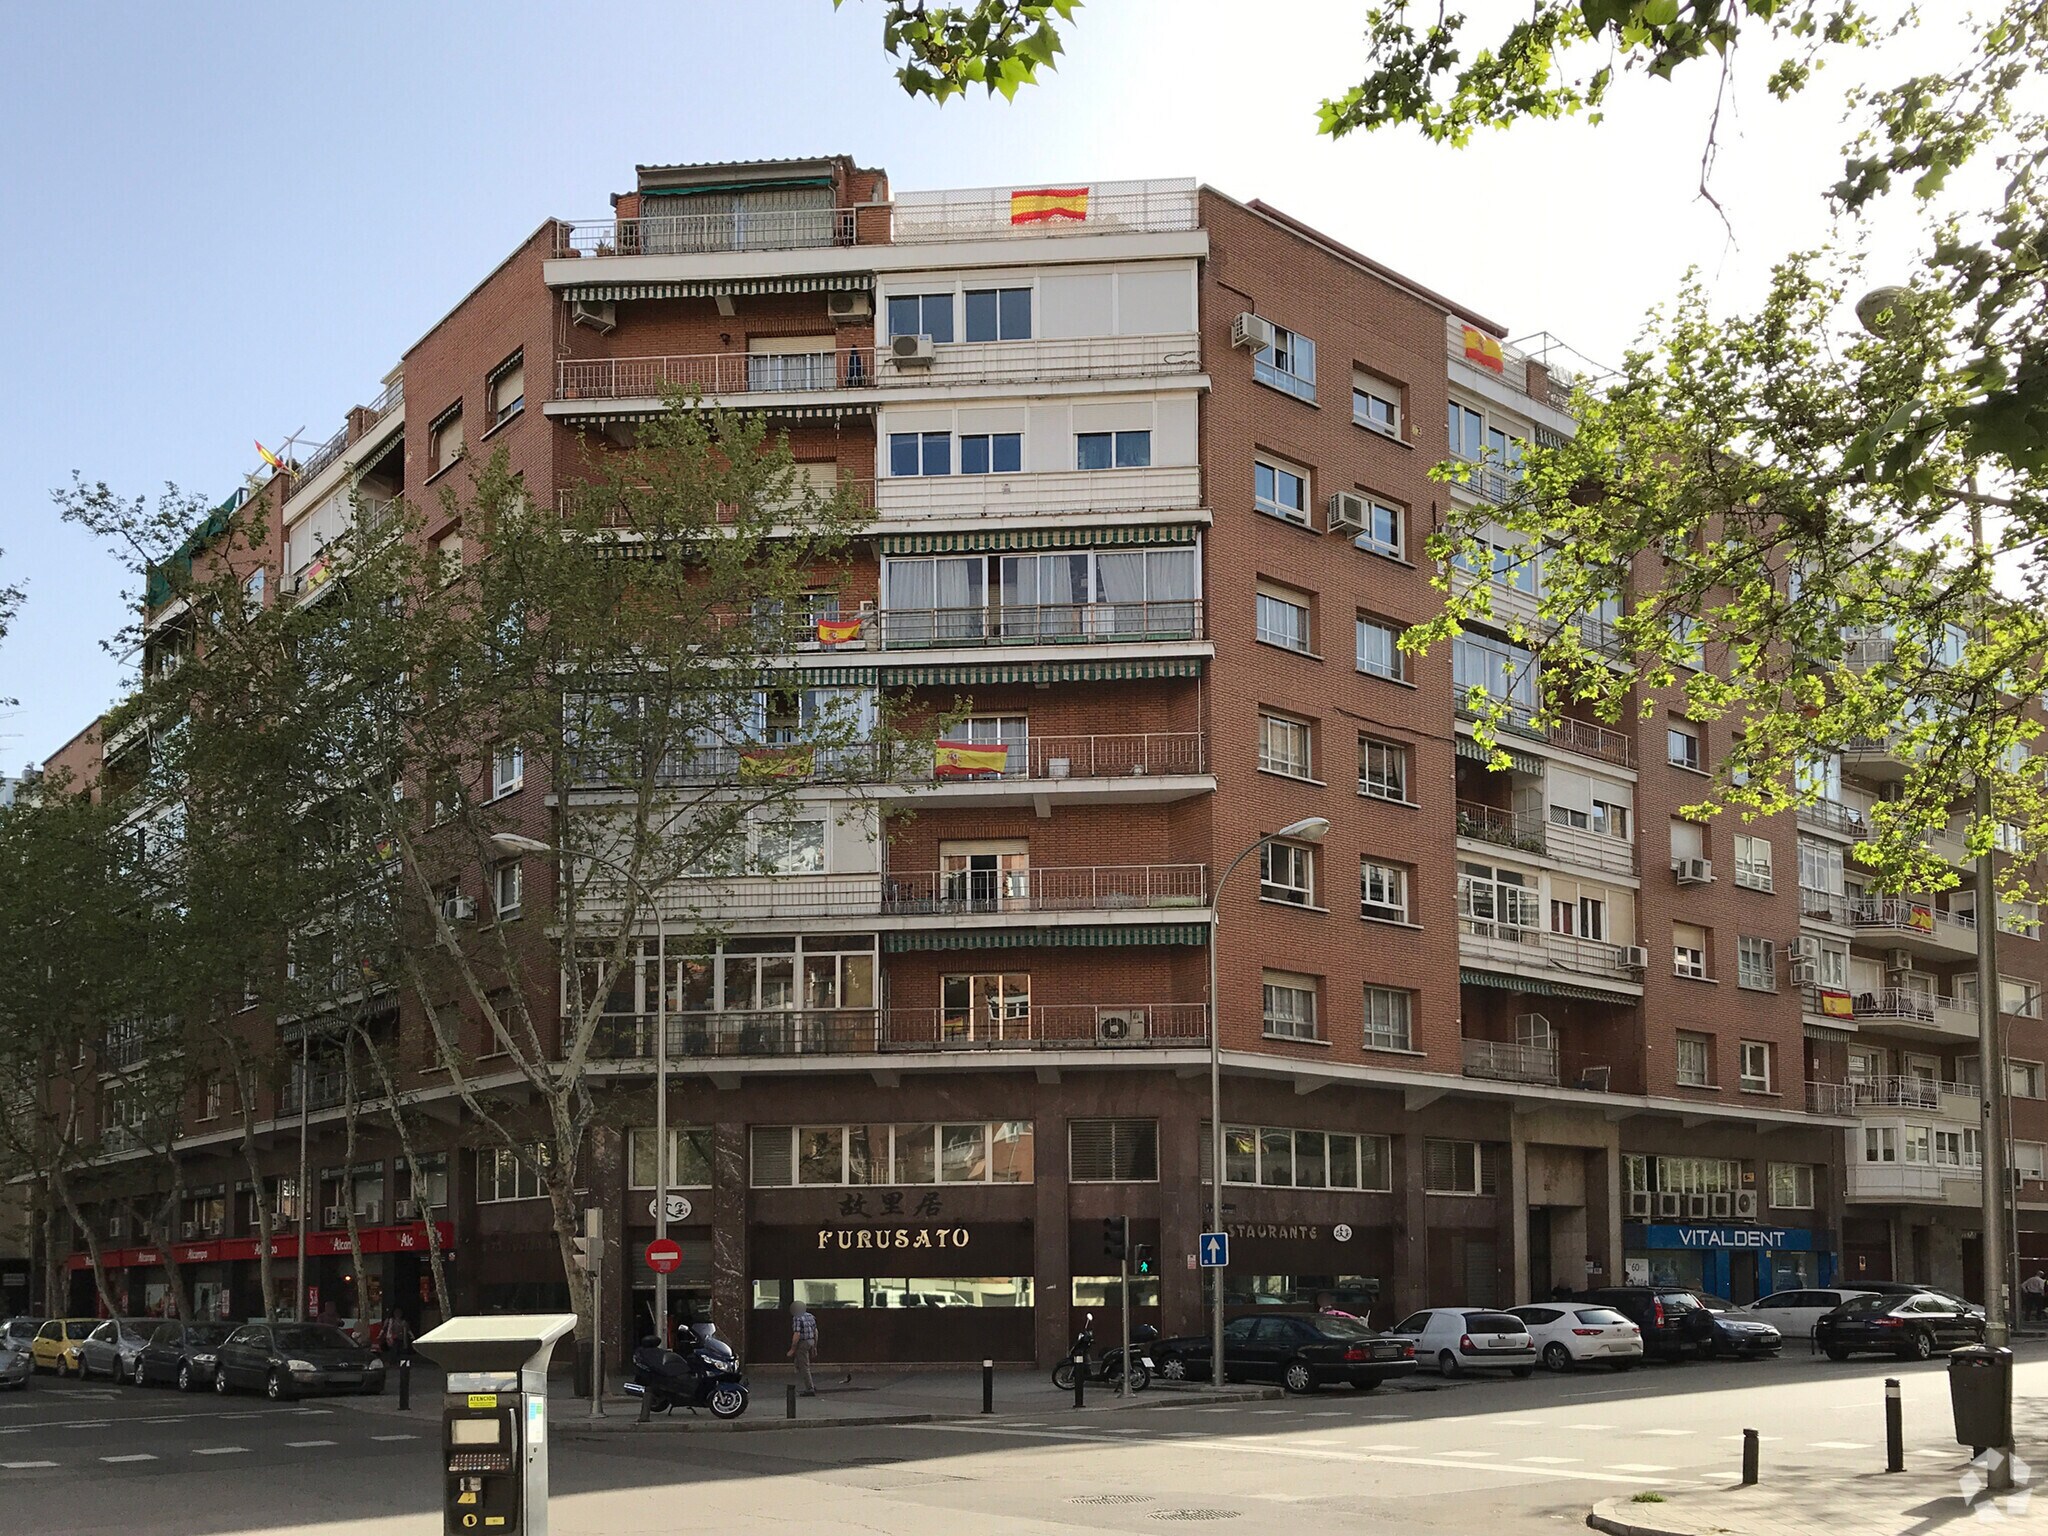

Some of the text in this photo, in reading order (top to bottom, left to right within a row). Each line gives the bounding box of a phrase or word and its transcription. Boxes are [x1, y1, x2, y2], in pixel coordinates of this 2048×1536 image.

[817, 1228, 970, 1250] FURUSATO
[1205, 1223, 1318, 1240] STAURANTE
[1679, 1229, 1786, 1247] VITALDENT
